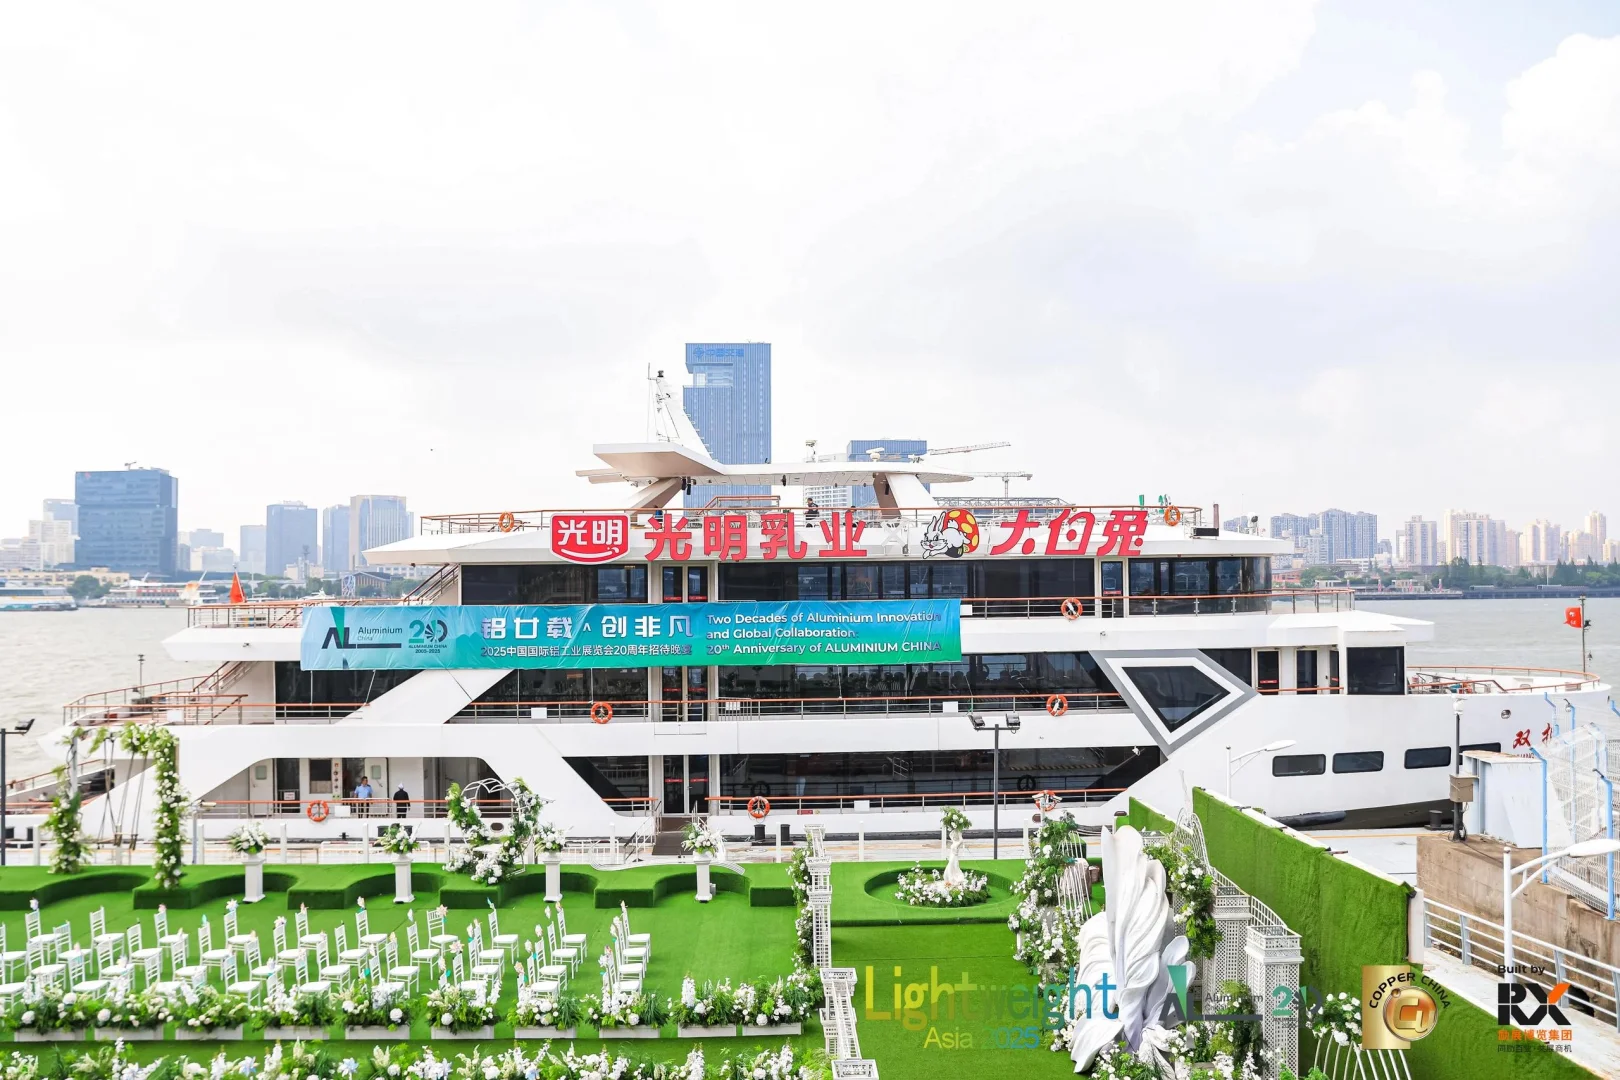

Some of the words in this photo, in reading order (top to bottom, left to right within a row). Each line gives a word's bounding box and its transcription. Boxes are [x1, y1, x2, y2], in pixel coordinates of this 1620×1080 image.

[558, 519, 623, 546] 光明
[644, 511, 867, 561] 光明乳业
[990, 509, 1149, 556] 大白兔
[707, 615, 731, 625] Two
[735, 613, 787, 624] Decades
[791, 613, 804, 622] of
[806, 612, 873, 623] Aluminium
[877, 610, 942, 622] Innovation
[358, 626, 403, 634] Aluminium
[706, 629, 730, 639] and
[733, 628, 772, 638] Global
[481, 644, 692, 657] 2025中国国际铝工业展览会20周年招待晚宴
[706, 644, 730, 655] 20th
[733, 643, 806, 655] Anniversary
[809, 643, 822, 652] of
[824, 642, 898, 653] ALUMINIUM
[901, 641, 941, 652] CHINA
